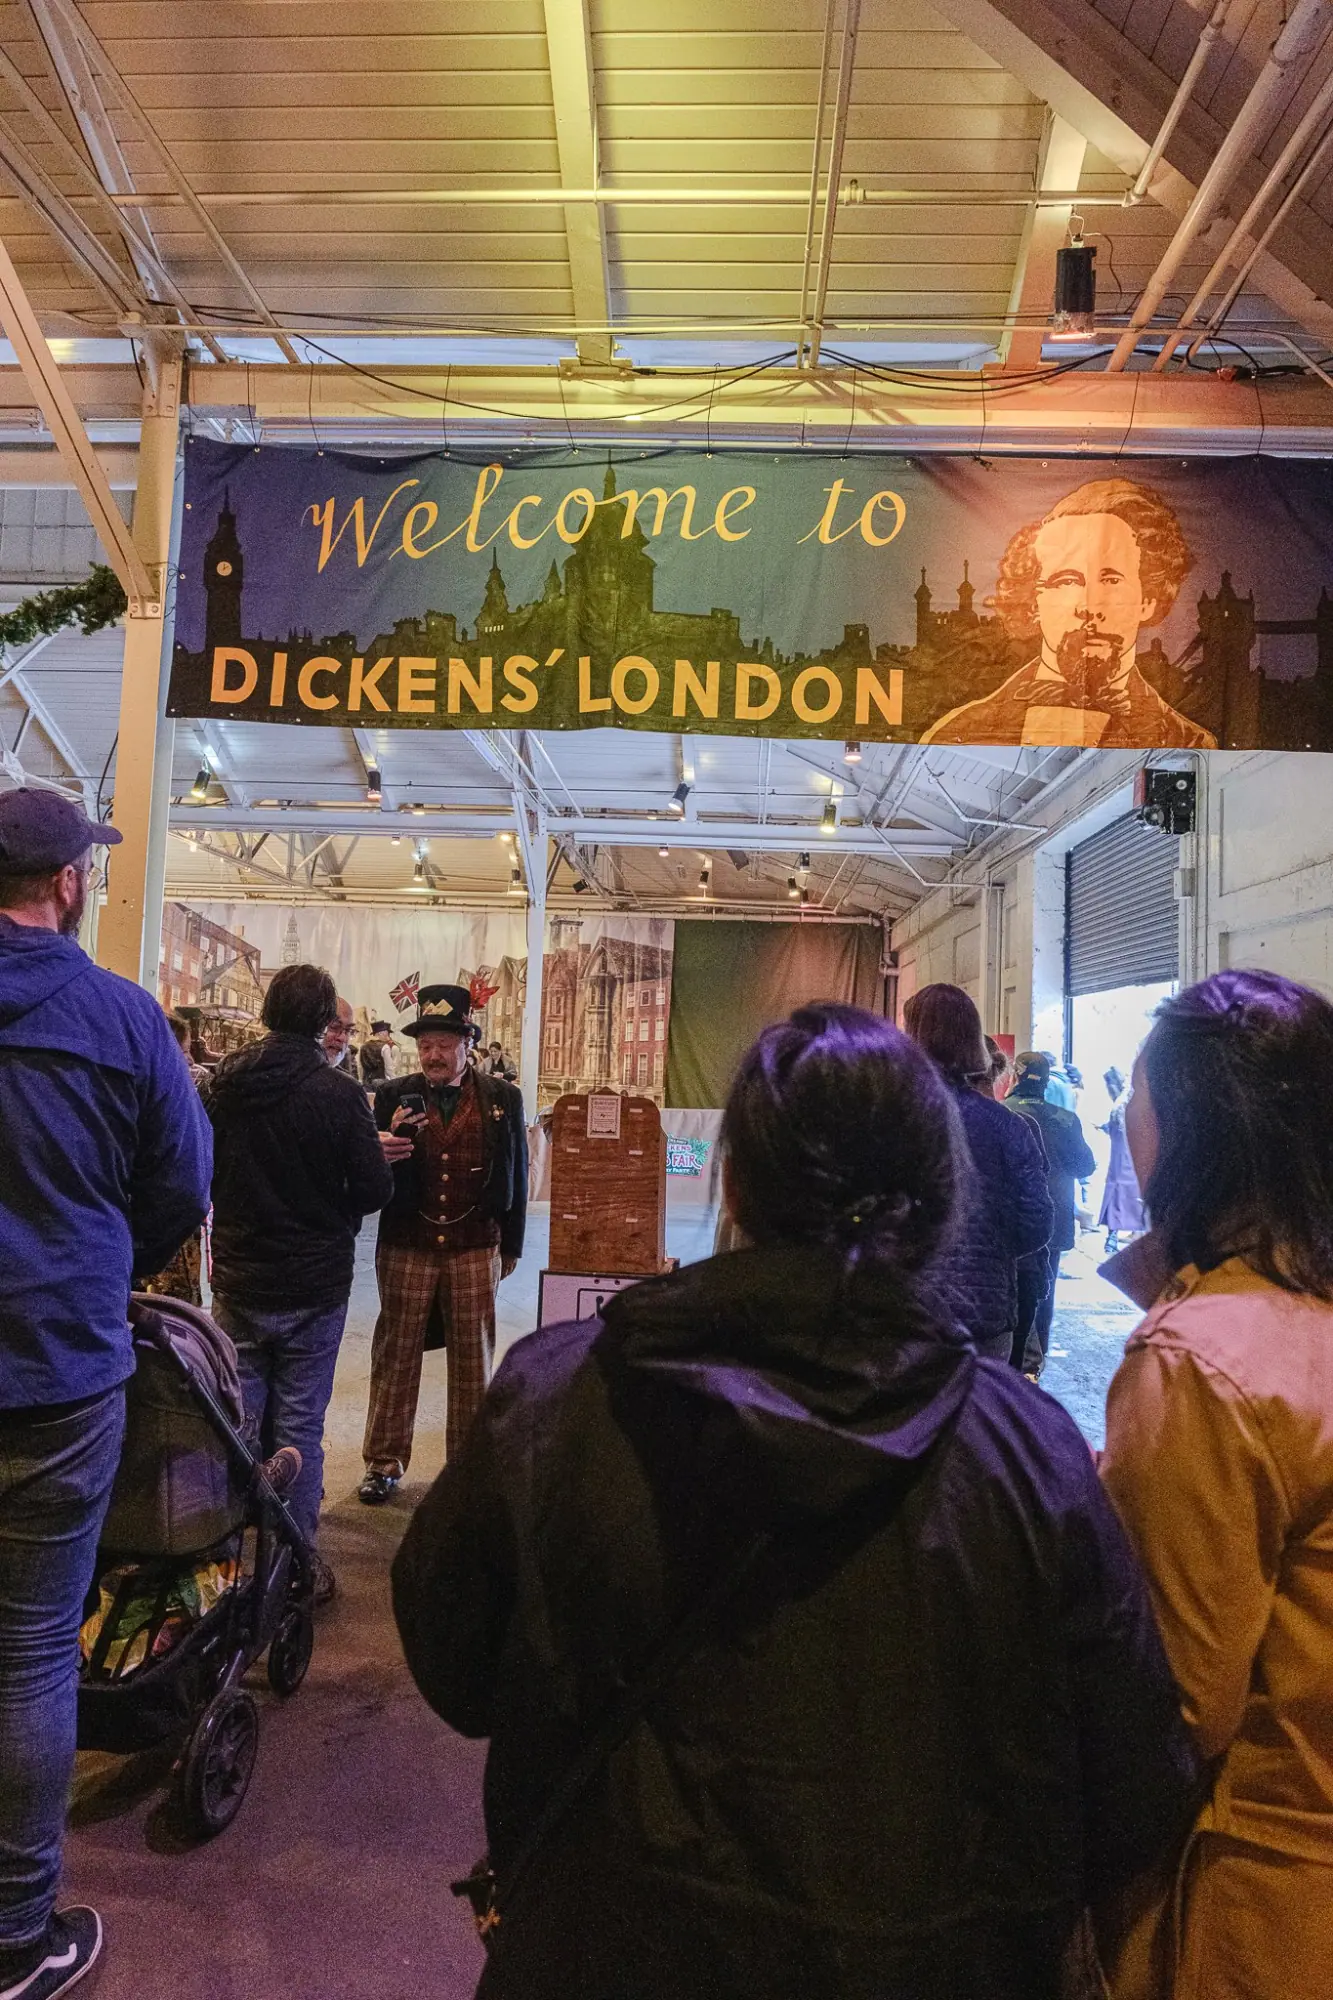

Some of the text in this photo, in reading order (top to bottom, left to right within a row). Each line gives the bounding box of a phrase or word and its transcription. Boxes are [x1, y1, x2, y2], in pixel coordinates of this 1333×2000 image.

[303, 463, 907, 573] Welcome to
[578, 655, 904, 726] LONDON
